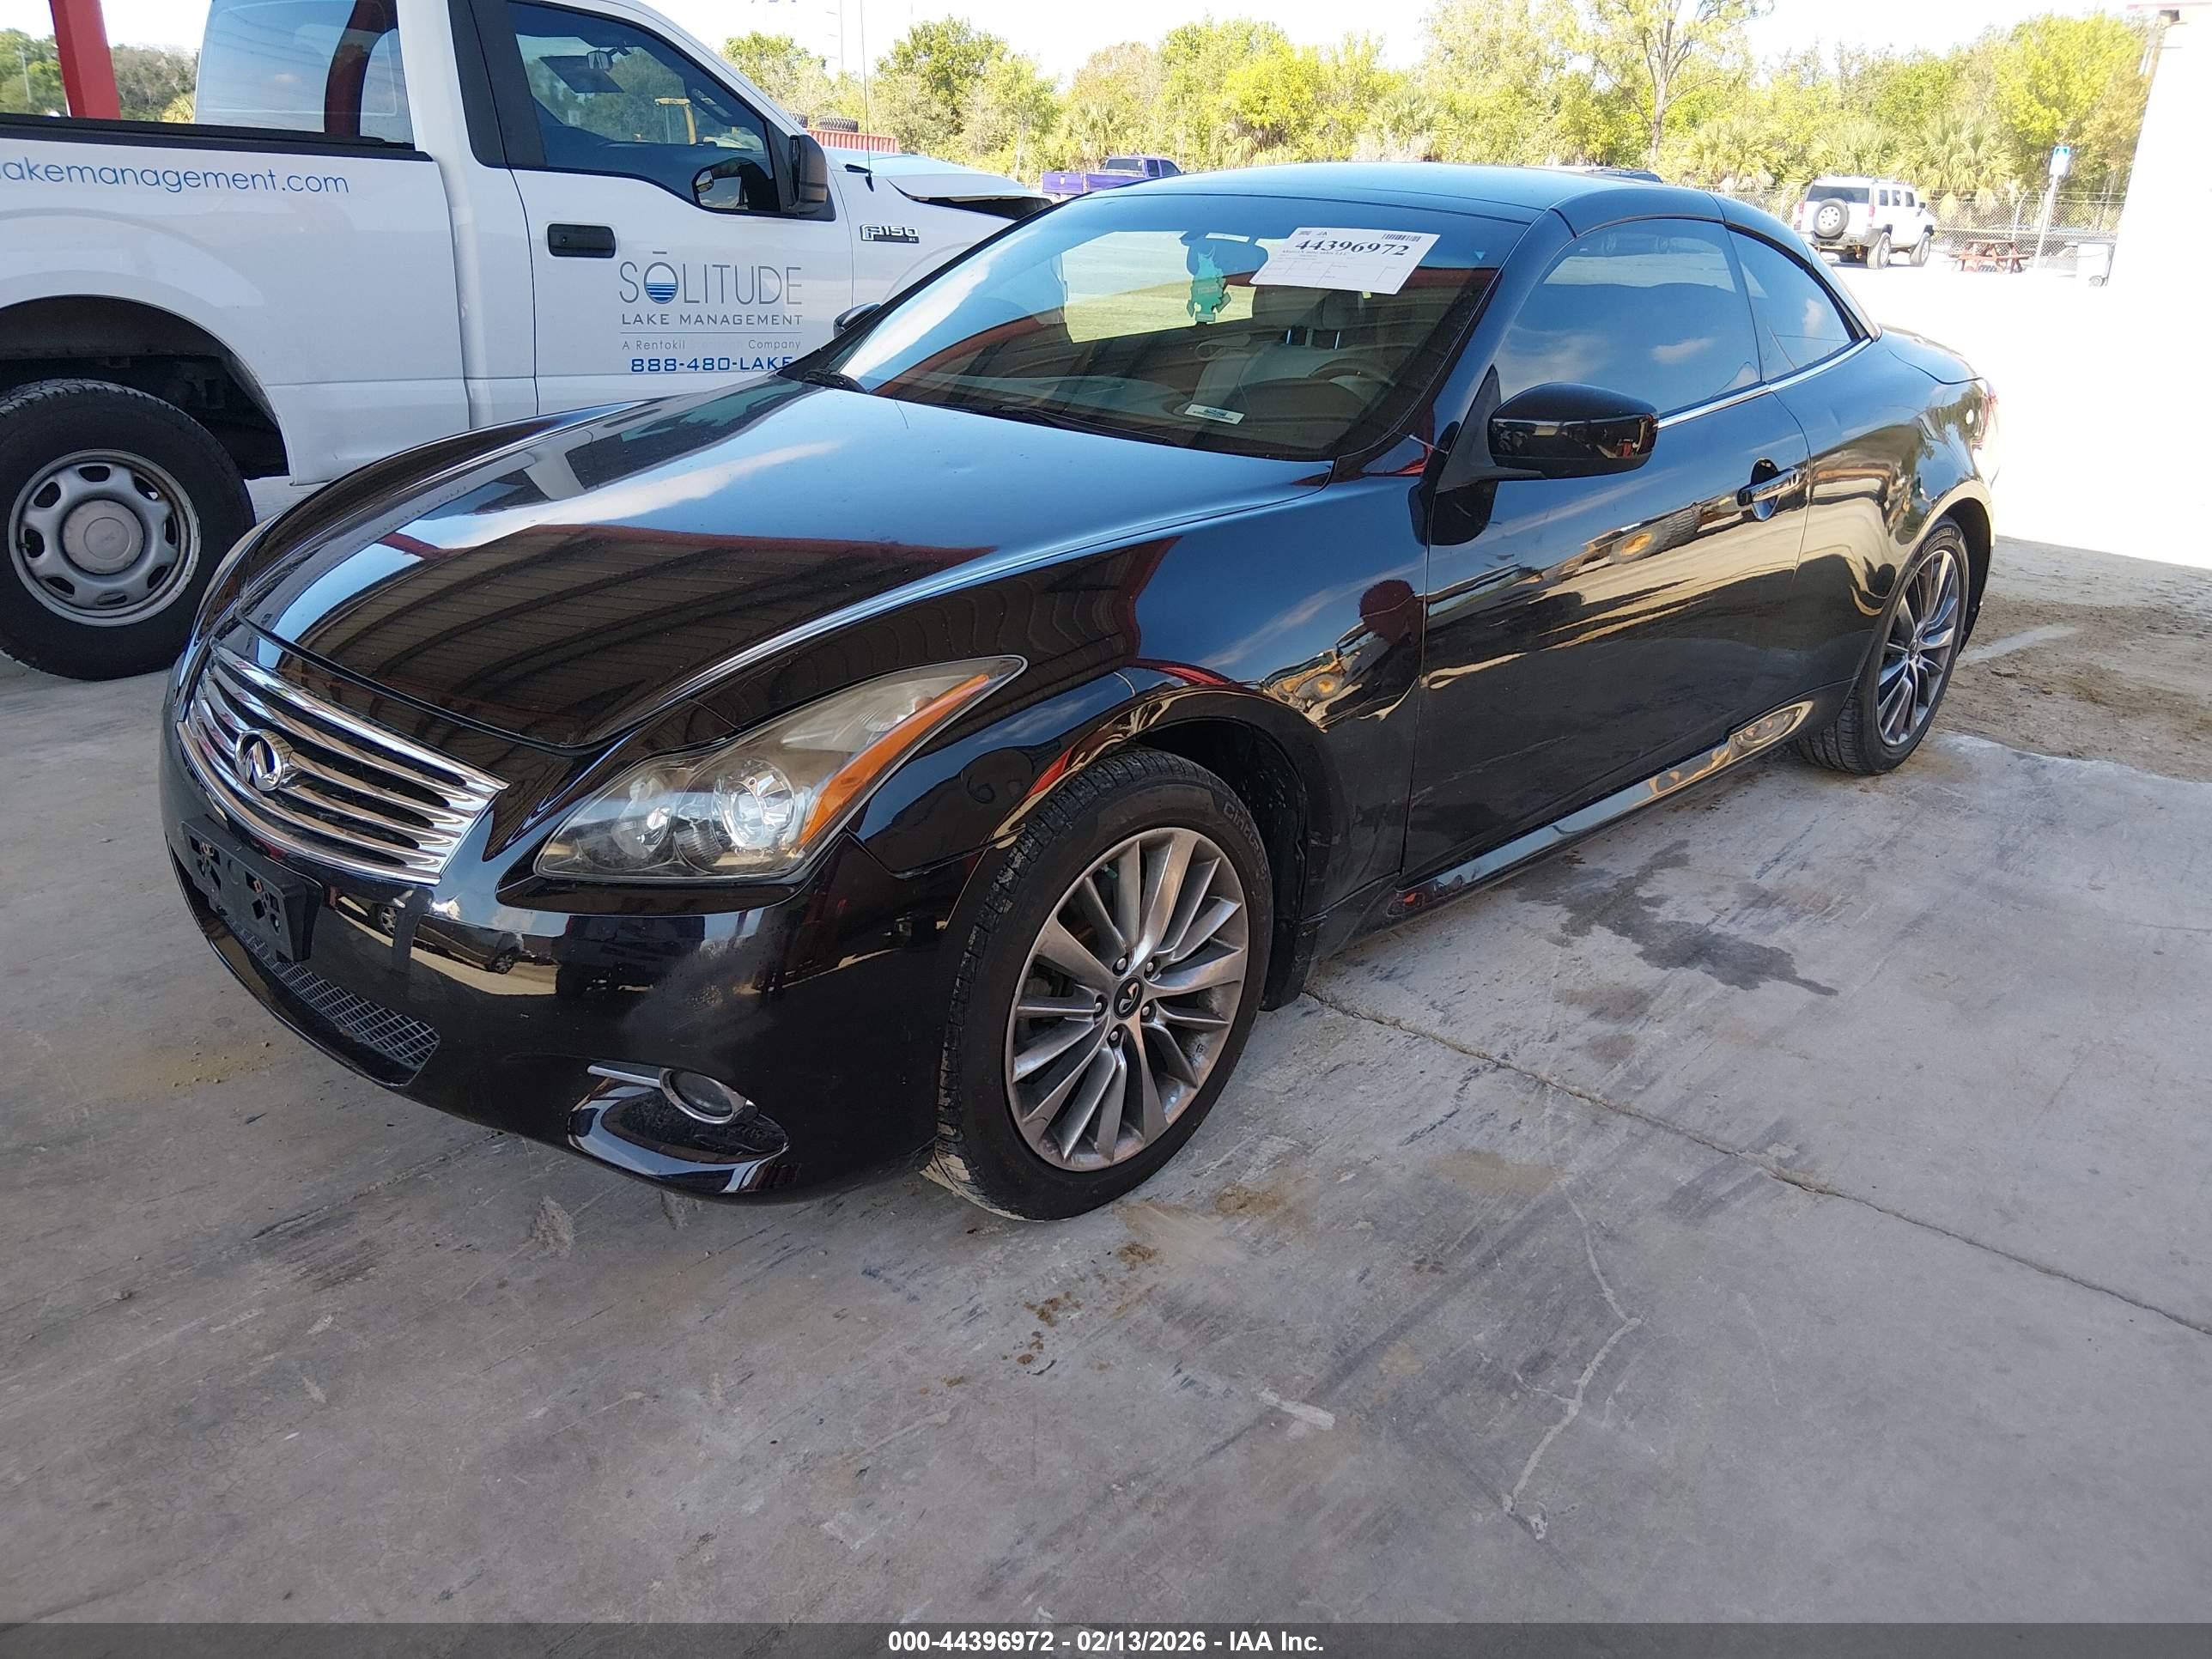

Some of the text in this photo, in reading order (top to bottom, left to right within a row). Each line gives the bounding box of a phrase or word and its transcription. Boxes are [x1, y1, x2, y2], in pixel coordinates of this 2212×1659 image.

[0, 157, 349, 194] akemanagement.com
[1295, 239, 1409, 257] 44396972
[622, 313, 803, 326] LAKE MANAGEMENT
[622, 339, 801, 350] A Rentokil Company
